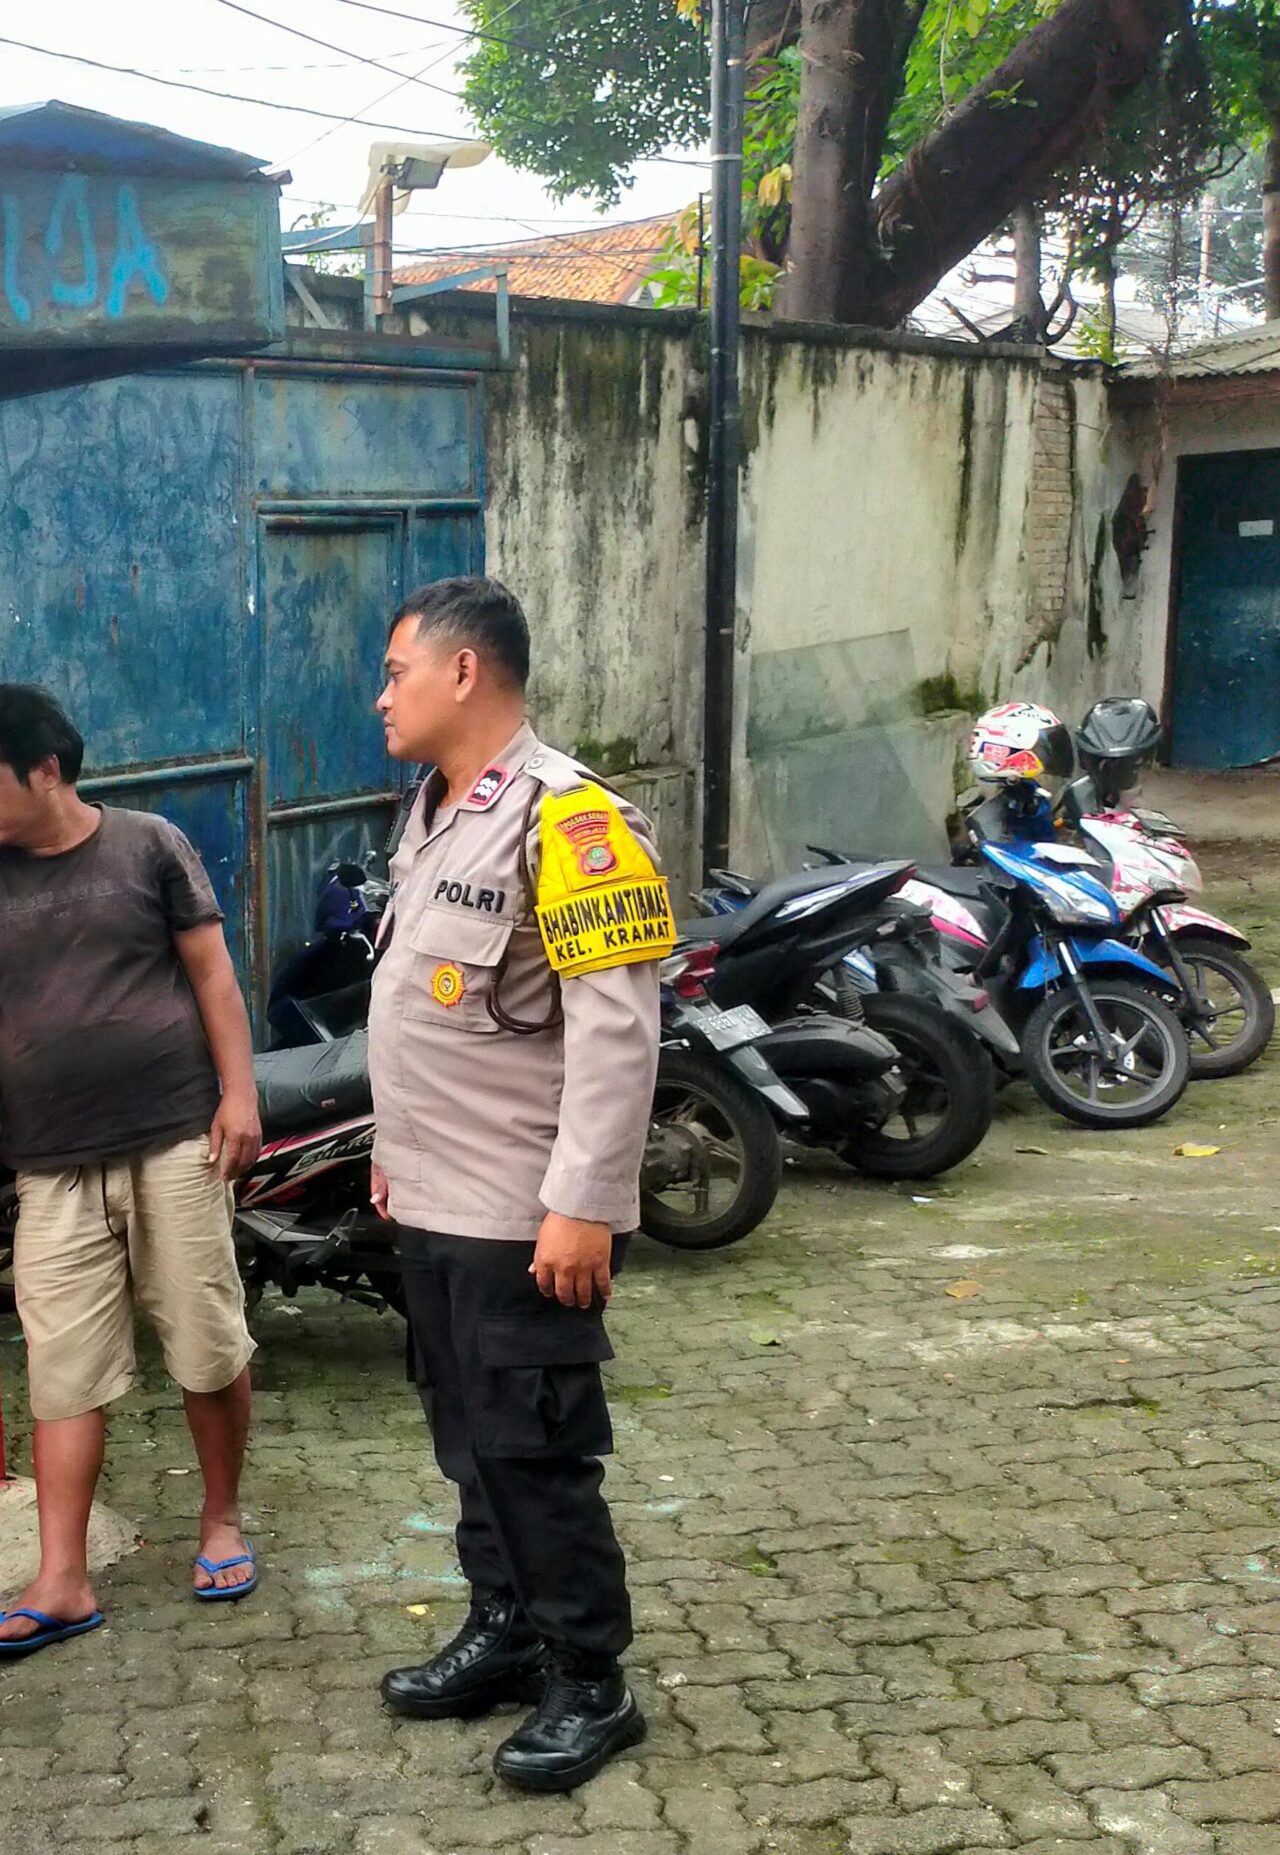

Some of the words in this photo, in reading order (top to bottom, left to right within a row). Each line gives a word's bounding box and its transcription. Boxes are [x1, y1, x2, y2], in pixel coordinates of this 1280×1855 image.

[434, 879, 506, 914] POLRI
[542, 885, 668, 944] BHABINKAMTIBMAS
[555, 939, 592, 962] KEL.
[603, 921, 670, 948] KRAMAT
